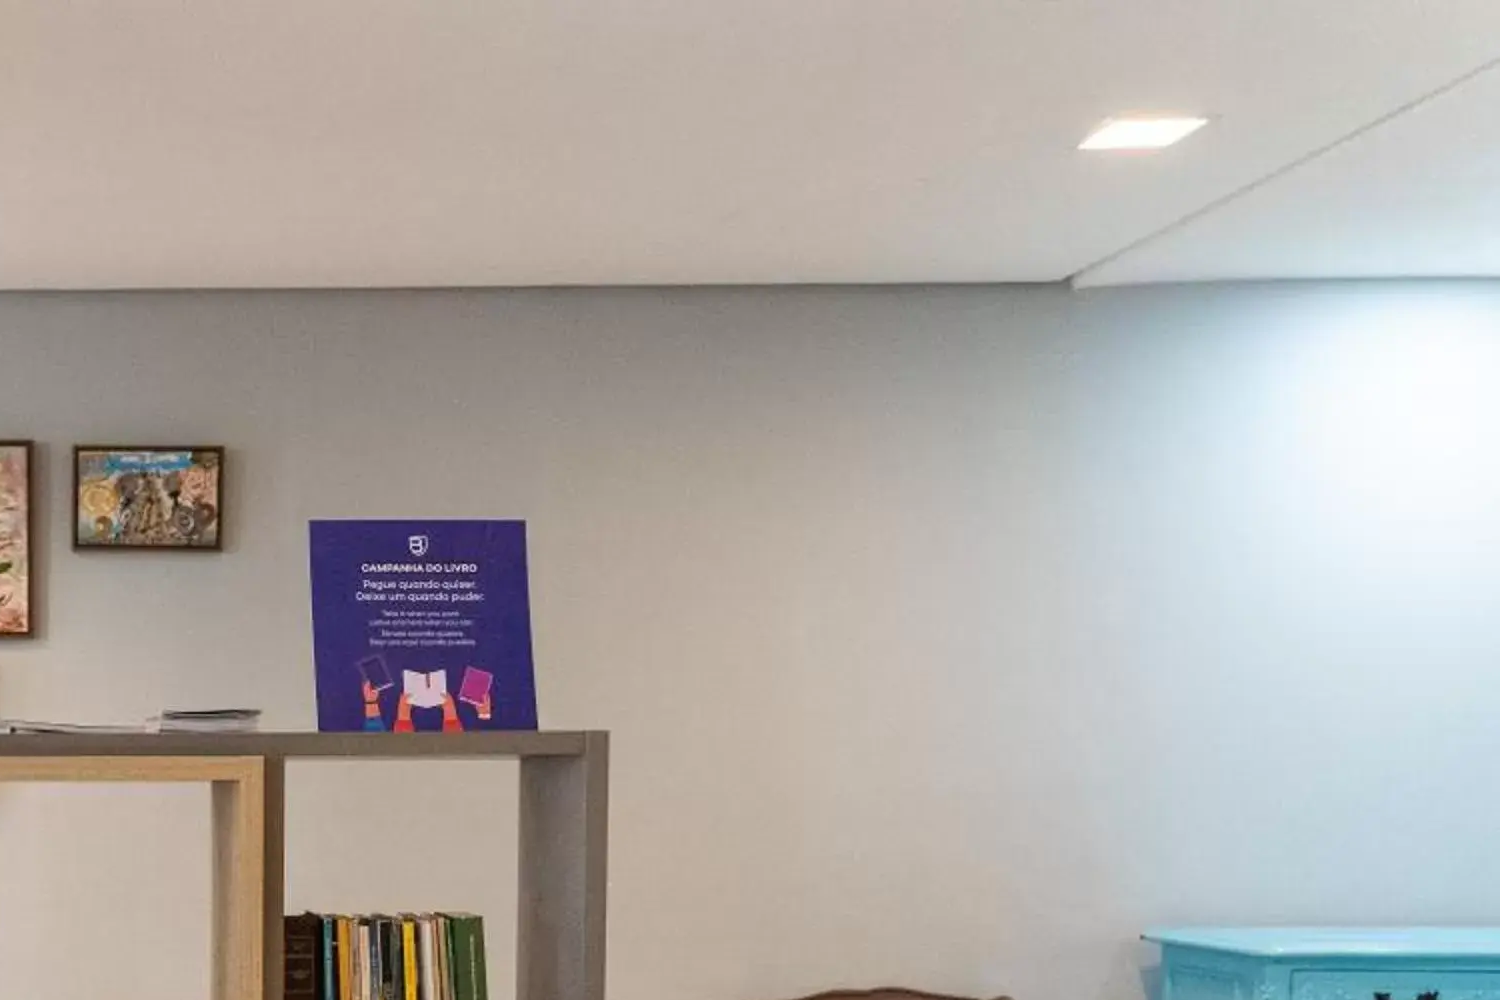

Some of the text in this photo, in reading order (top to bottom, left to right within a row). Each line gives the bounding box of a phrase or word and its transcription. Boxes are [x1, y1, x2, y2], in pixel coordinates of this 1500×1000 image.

[360, 563, 478, 573] CAMPANHA DO LIVRO
[363, 580, 397, 591] Pegue
[398, 580, 441, 590] quando
[355, 592, 386, 601] Deixe
[387, 593, 407, 601] um
[407, 592, 449, 602] quando
